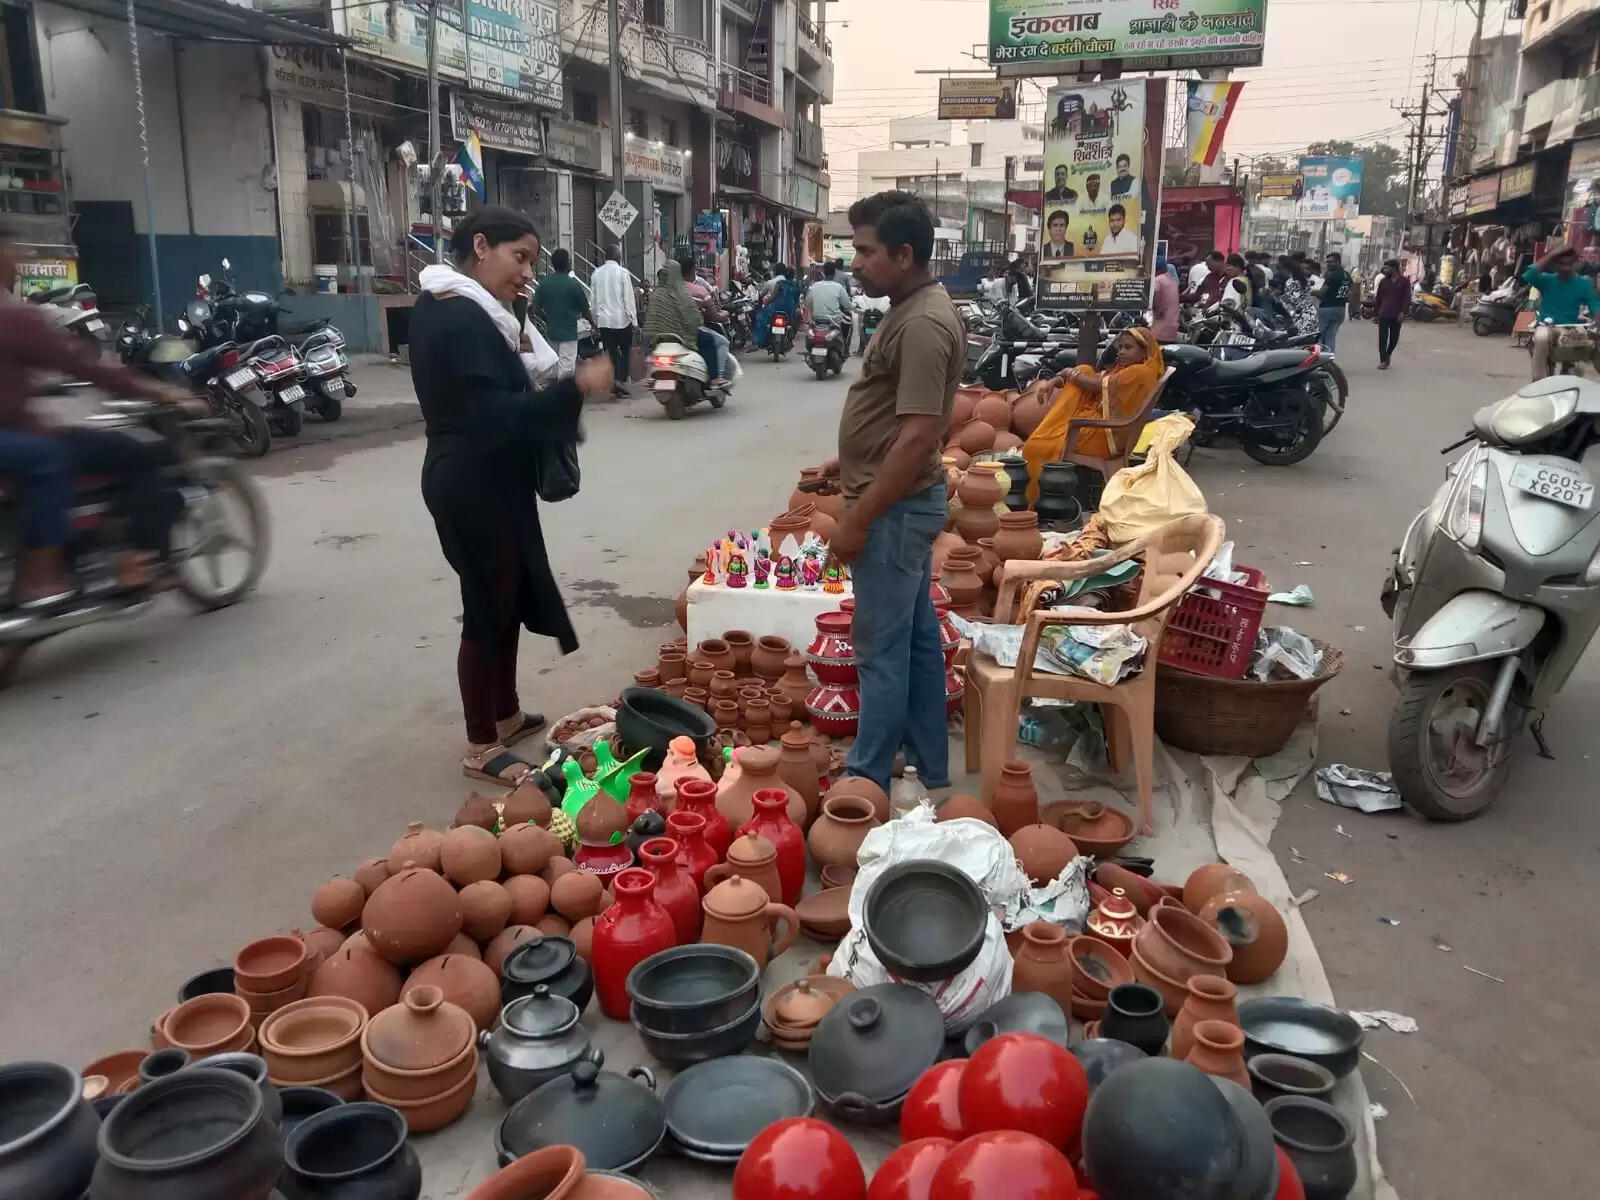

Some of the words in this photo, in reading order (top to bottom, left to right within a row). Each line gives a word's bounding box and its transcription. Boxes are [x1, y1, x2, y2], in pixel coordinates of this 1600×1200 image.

[1010, 10, 1102, 39] इंकलाब
[1129, 12, 1177, 34] आजादी
[1179, 10, 1199, 31] के
[1201, 8, 1256, 30] मतवाले
[470, 15, 521, 54] DELUXE
[523, 34, 560, 66] SHOES
[996, 44, 1017, 59] मेरा
[1019, 41, 1037, 57] रंग
[1039, 40, 1050, 57] दे
[1051, 38, 1083, 55] बसंती
[1084, 37, 1115, 53] चोला
[471, 78, 483, 89] THE
[484, 81, 513, 97] COMPLETE
[1528, 479, 1584, 505] X6201
[1537, 470, 1582, 491] CG05
